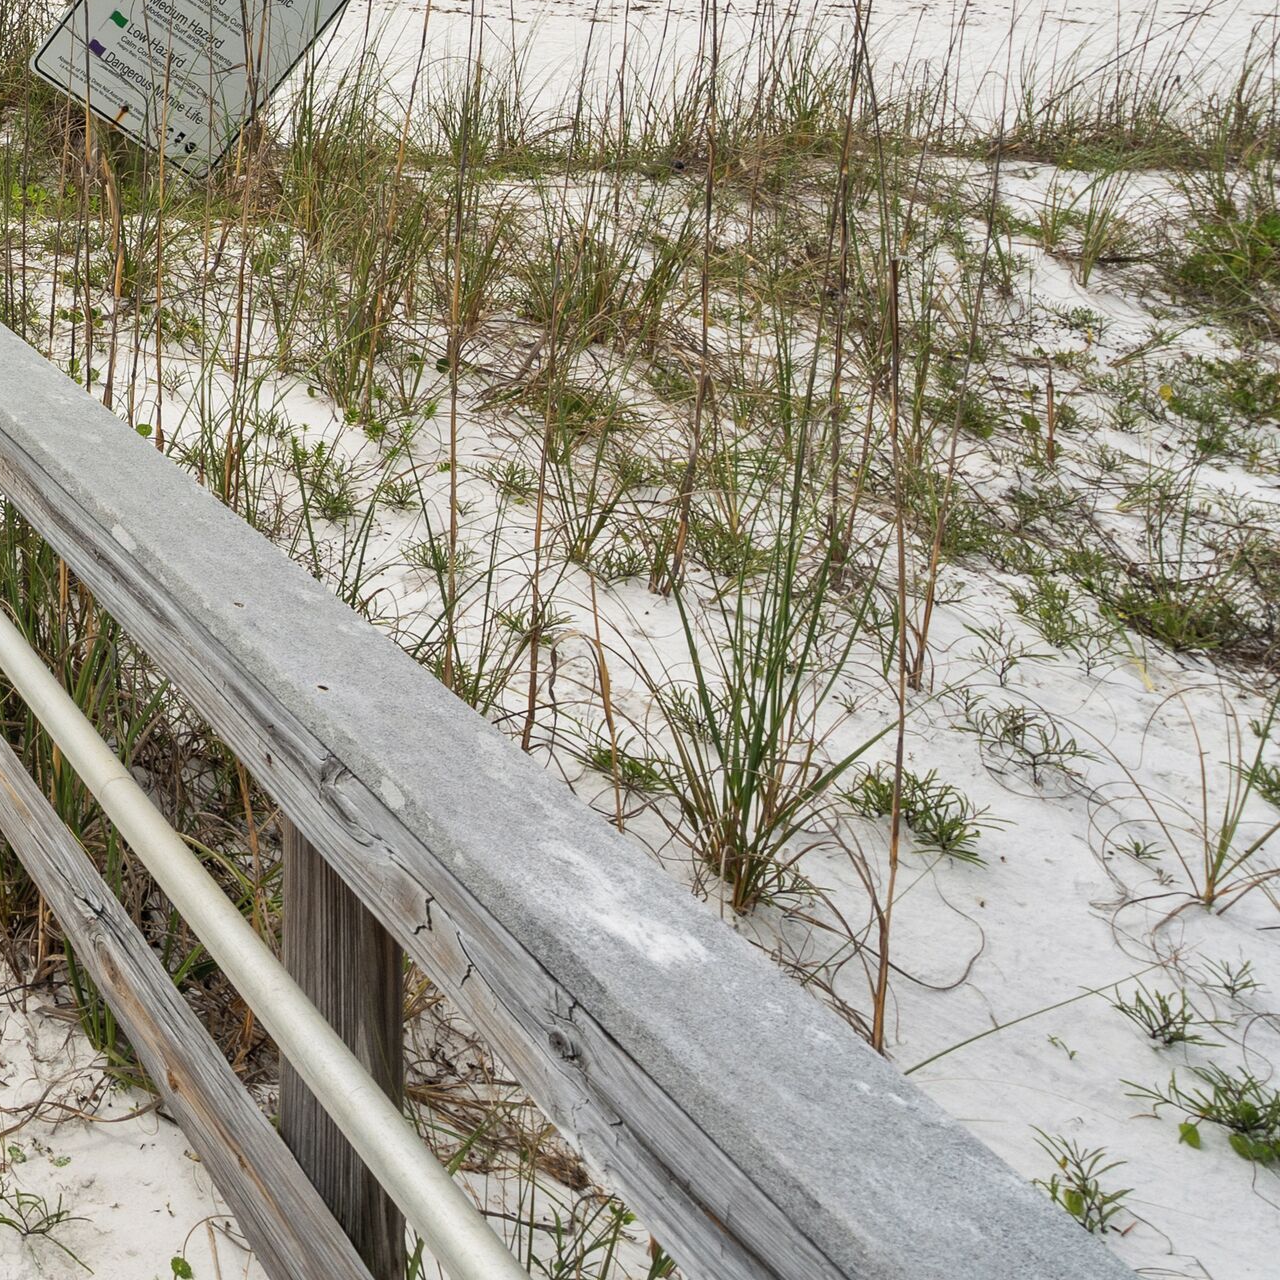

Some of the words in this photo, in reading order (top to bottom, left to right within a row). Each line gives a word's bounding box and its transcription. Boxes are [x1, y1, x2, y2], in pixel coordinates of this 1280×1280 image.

[210, 4, 231, 21] Strong
[119, 34, 138, 49] Calm
[126, 23, 150, 43] Low
[172, 23, 187, 35] Surf
[186, 32, 206, 48] and/o
[186, 19, 225, 49] Hazard
[103, 51, 155, 90] Dangerous
[184, 106, 205, 125] Life
